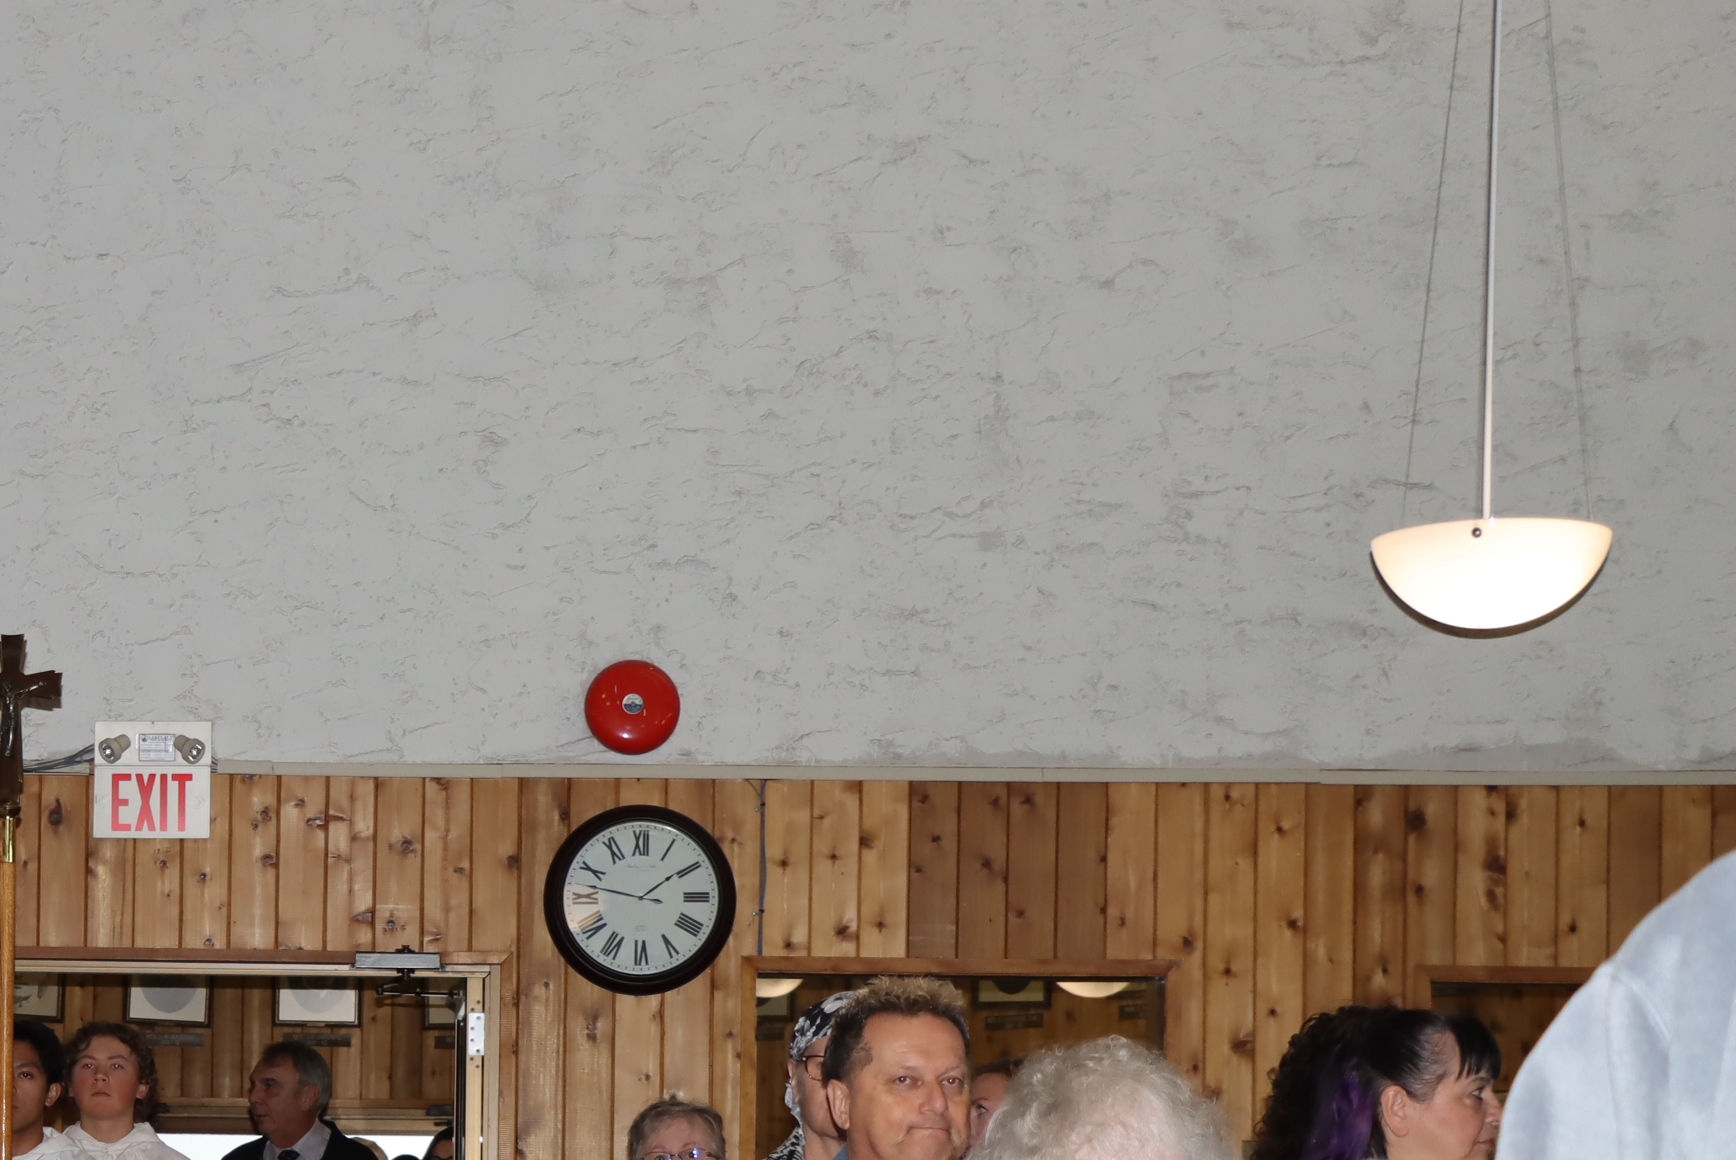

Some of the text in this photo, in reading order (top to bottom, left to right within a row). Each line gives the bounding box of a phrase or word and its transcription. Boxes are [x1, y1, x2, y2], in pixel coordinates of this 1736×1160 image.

[111, 773, 193, 832] EXIT
[602, 836, 626, 865] XI
[632, 830, 650, 857] XII
[579, 860, 606, 882] X
[675, 860, 702, 879] II
[572, 891, 599, 905] IX
[683, 892, 710, 903] III
[577, 910, 607, 940] VIII
[674, 912, 704, 938] IIII
[600, 931, 625, 961] VII
[634, 939, 649, 966] VI
[661, 933, 680, 959] V
